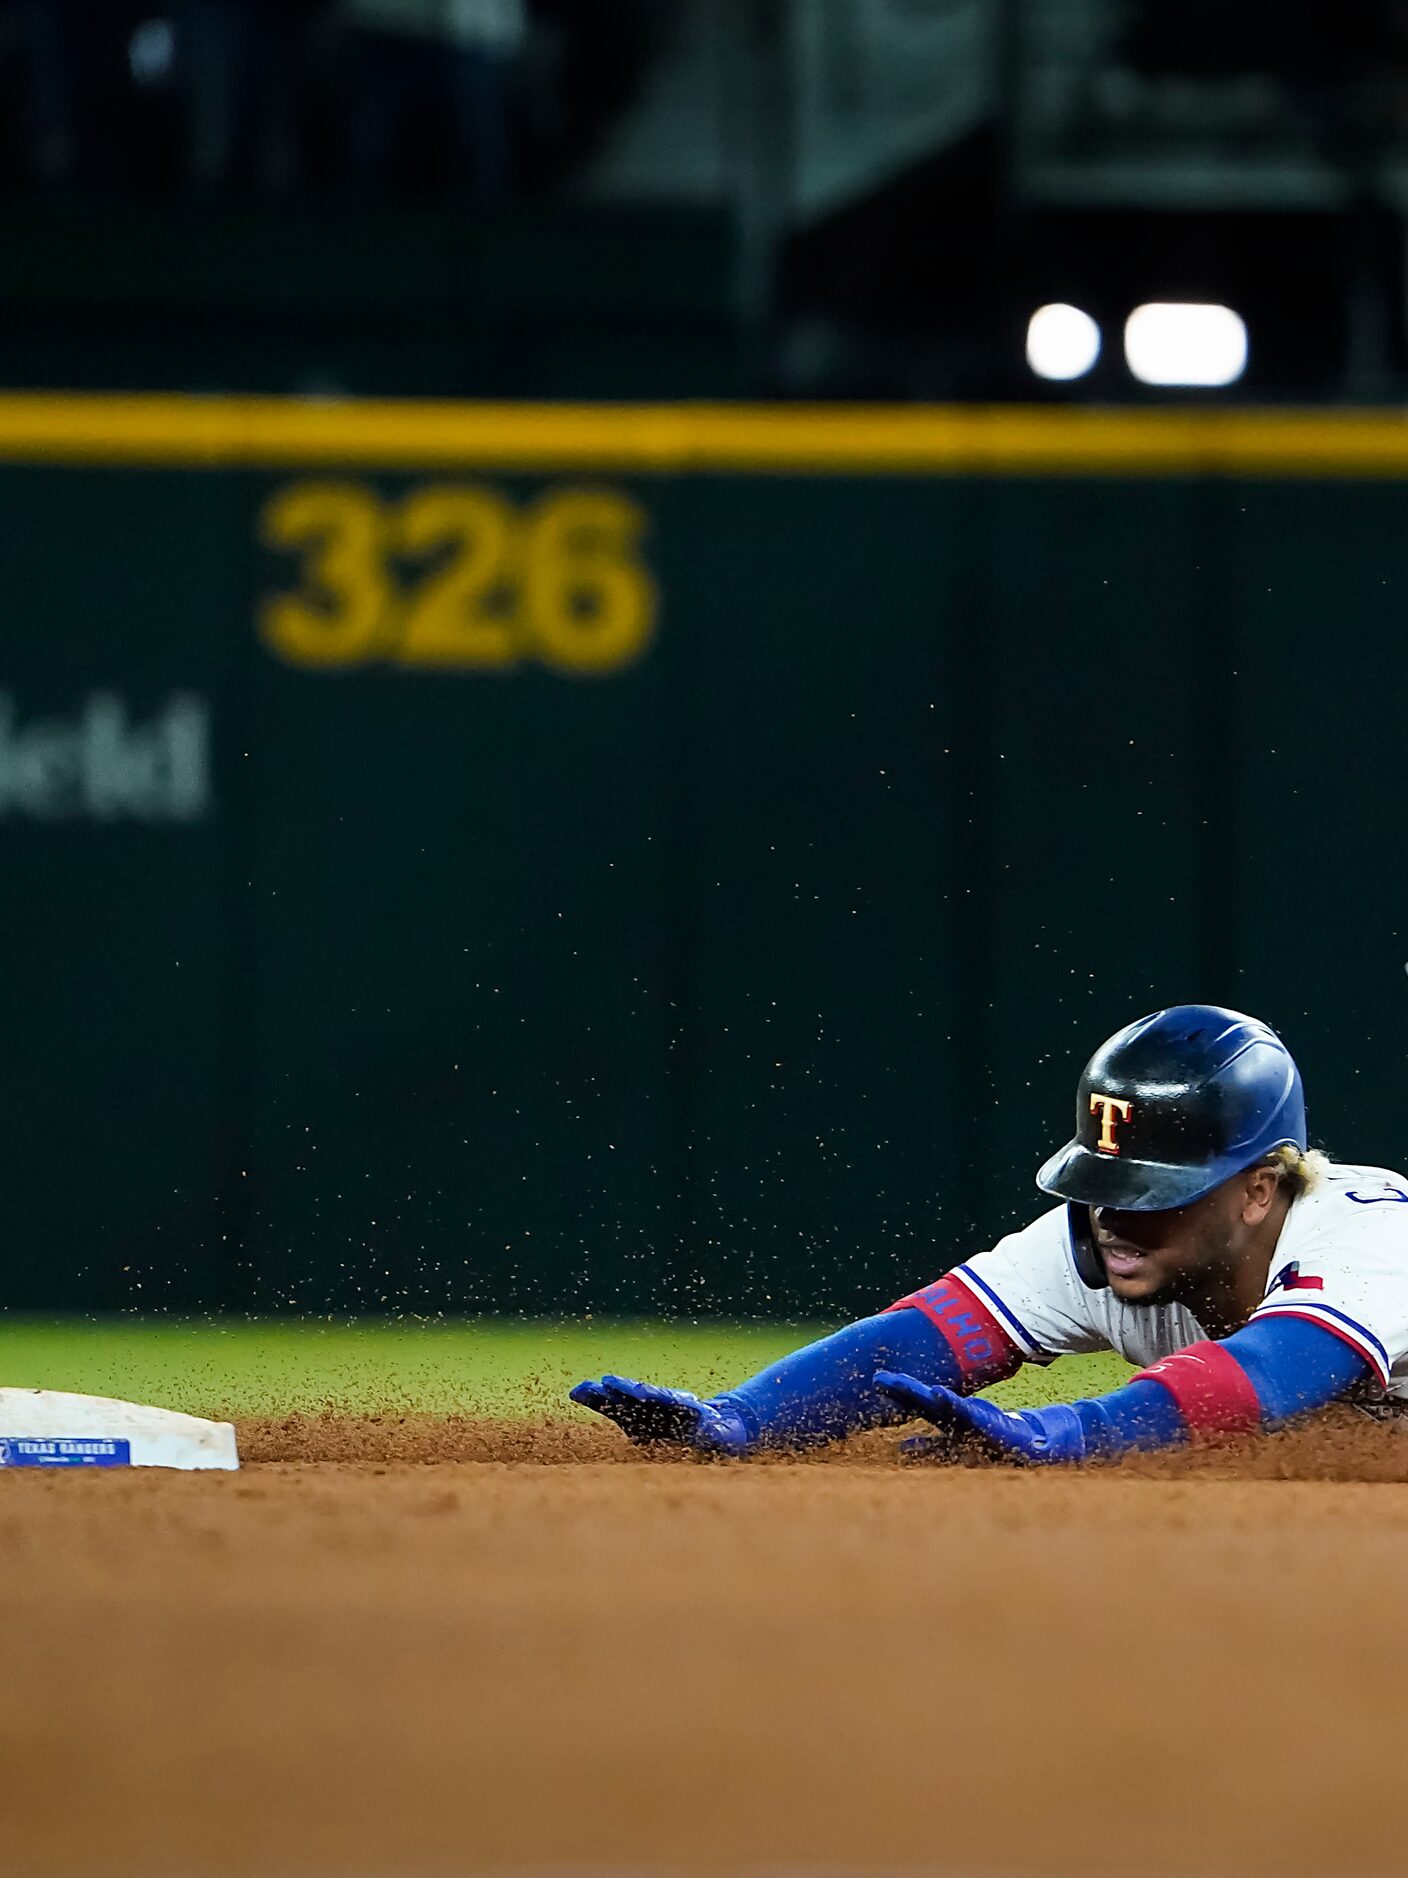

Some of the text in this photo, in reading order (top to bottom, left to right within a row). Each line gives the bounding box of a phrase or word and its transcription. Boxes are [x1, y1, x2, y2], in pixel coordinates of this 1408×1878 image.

[261, 482, 657, 674] 326
[1088, 1092, 1134, 1155] T
[17, 1442, 56, 1455] TEXAS
[59, 1442, 117, 1456] RANGERS
